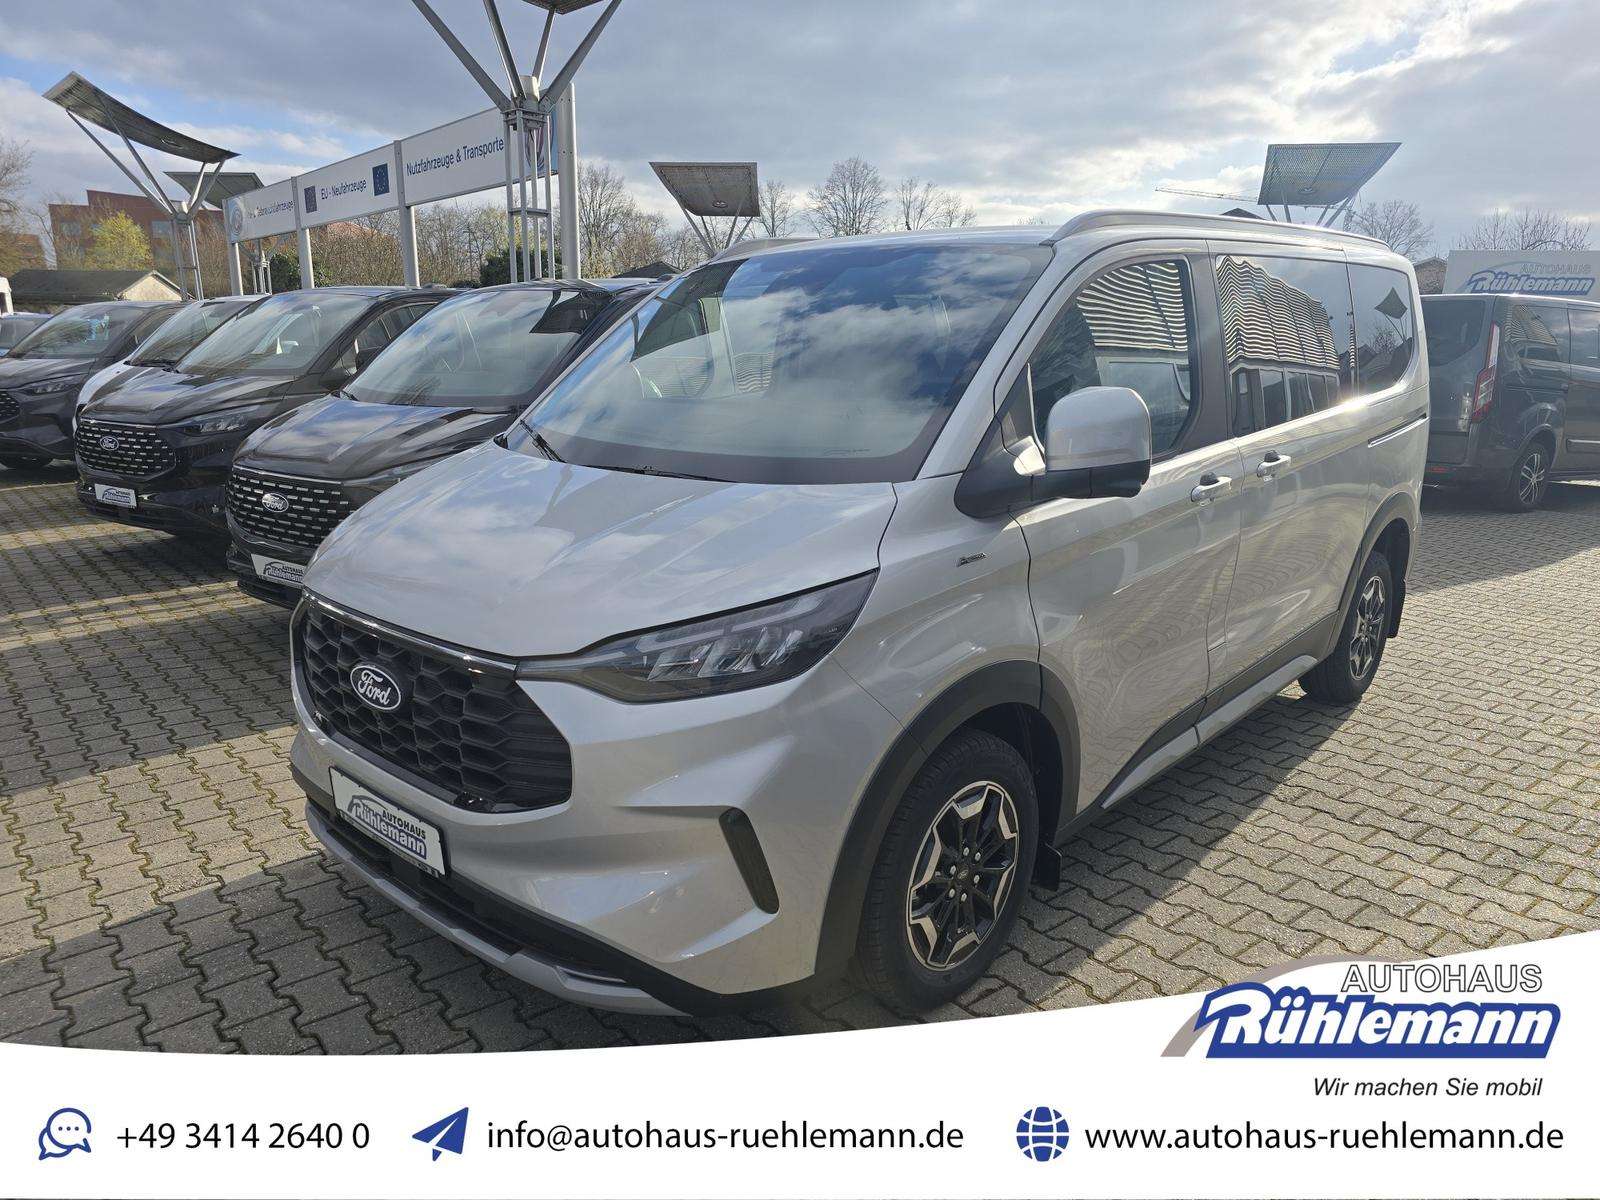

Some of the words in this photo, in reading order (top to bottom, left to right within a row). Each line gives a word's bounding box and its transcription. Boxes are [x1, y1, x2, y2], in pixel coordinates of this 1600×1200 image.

[406, 152, 454, 176] Nutzfahrzeuge
[456, 148, 462, 163] &
[463, 137, 505, 161] Transporte
[320, 187, 329, 200] EU
[331, 179, 367, 197] Neufahrzeuge
[1468, 270, 1595, 294] Rühlemann
[1521, 263, 1592, 275] AUTOHAUS
[357, 670, 391, 705] Ford
[349, 799, 427, 858] Rühlemann
[382, 809, 426, 840] AUTOHAUS
